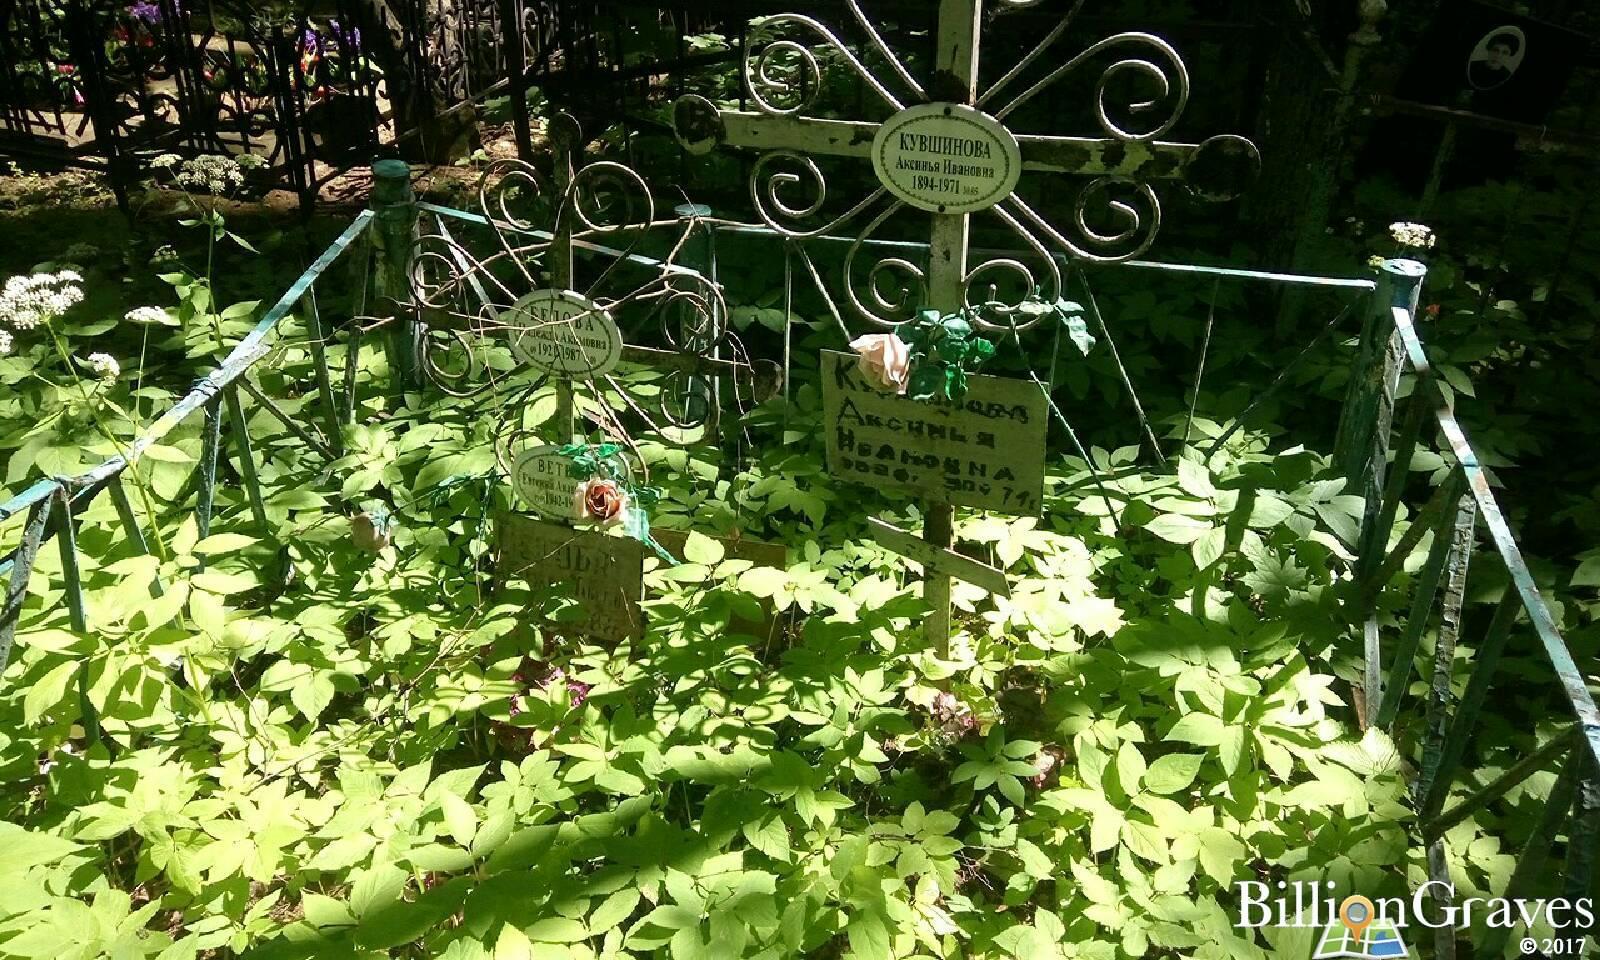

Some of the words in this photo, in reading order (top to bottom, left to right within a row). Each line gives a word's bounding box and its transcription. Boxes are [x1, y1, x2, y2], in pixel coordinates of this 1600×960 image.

[900, 132, 991, 159] КУВШИНОВА
[896, 155, 940, 173] Аксинья
[943, 159, 995, 178] Ивановна
[913, 175, 960, 194] 1894-1971
